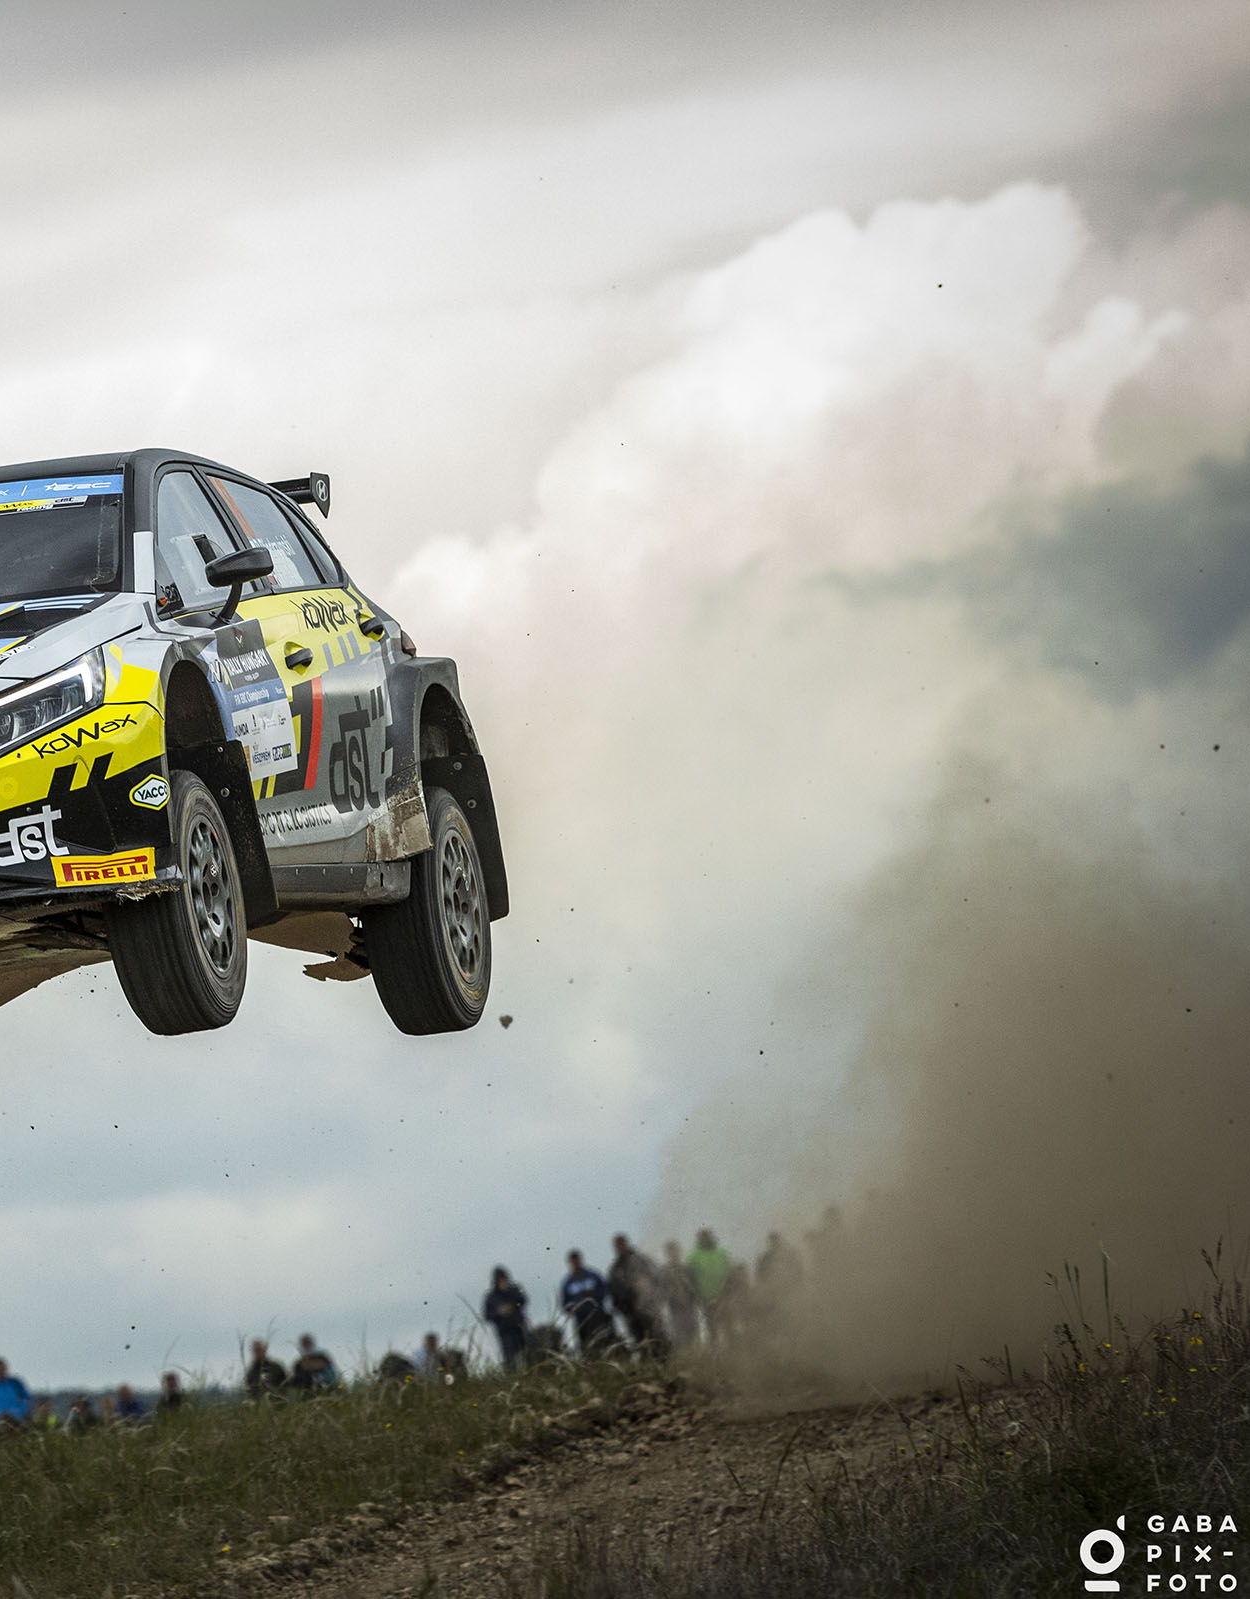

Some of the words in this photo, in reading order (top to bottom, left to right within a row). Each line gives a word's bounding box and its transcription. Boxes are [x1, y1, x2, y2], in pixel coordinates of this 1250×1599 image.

[223, 655, 244, 677] RALLY
[239, 648, 270, 672] HUNGARY
[32, 714, 138, 759] koWax
[329, 695, 381, 814] dst
[290, 802, 332, 830] LOGISTICS
[61, 855, 148, 882] PIRELLI
